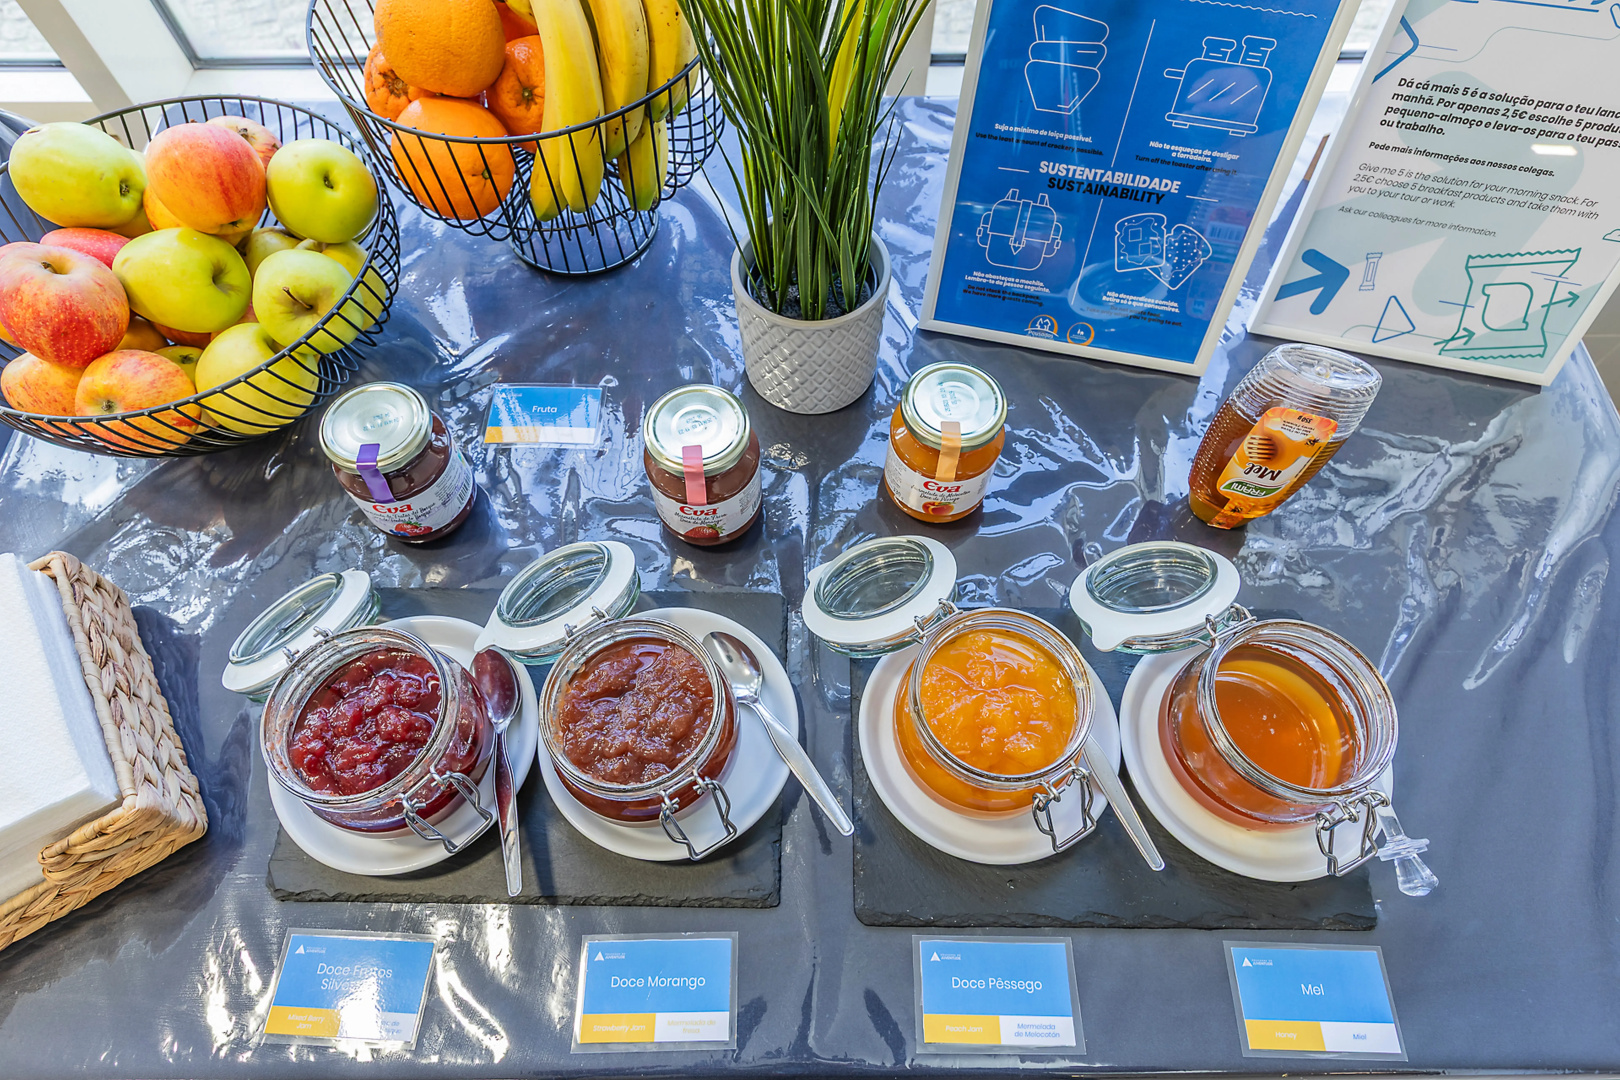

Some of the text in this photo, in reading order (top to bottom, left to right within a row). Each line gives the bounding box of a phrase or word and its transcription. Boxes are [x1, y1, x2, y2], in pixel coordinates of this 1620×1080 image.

[1398, 78, 1414, 88] Dá
[1415, 80, 1430, 90] cá
[1431, 84, 1460, 95] mais
[1462, 87, 1470, 96] 5
[1470, 88, 1479, 97] é
[1489, 93, 1535, 106] solução
[1534, 100, 1565, 110] para
[1575, 104, 1595, 114] teu
[1392, 93, 1434, 105] manhã.
[1436, 98, 1457, 108] Por
[1457, 102, 1501, 117] apenas
[1501, 108, 1528, 119] 2,5€
[1528, 113, 1573, 126] escolhe
[1575, 119, 1584, 127] 5
[995, 123, 1008, 131] Suja
[1014, 126, 1039, 135] mínimo
[1048, 130, 1063, 139] loiça
[1380, 119, 1445, 135] ou trabalho.
[1384, 106, 1483, 128] pequeno-almoço
[1492, 121, 1537, 135] leva-os
[1536, 129, 1566, 139] para
[1577, 134, 1596, 144] teu
[1048, 143, 1075, 153] crockery
[1149, 141, 1163, 149] Não
[1171, 146, 1202, 155] esqueças
[1172, 160, 1195, 170] toaster
[1177, 152, 1212, 163] torradeira.
[1369, 142, 1390, 151] Pede
[1391, 143, 1413, 154] mais
[1414, 148, 1469, 163] informações
[1486, 162, 1518, 171] nossos
[1518, 166, 1555, 176] colegas.
[1039, 160, 1181, 194] SUSTENTABILIDADE
[1047, 177, 1165, 205] SUSTAINABILITY
[1359, 163, 1379, 173] Give
[1380, 166, 1397, 175] me
[1397, 168, 1405, 177] 5
[1415, 172, 1431, 181] the
[1432, 174, 1469, 187] solution
[1469, 180, 1484, 188] for
[1483, 183, 1507, 193] your
[1506, 186, 1549, 201] morning
[1549, 193, 1579, 205] snack.
[1580, 199, 1599, 208] For
[1347, 185, 1366, 194] you
[1367, 187, 1377, 195] to
[1377, 190, 1400, 199] your
[1400, 193, 1421, 202] tour
[1432, 197, 1455, 208] work.
[1375, 177, 1409, 189] choose
[1419, 184, 1463, 197] breakfast
[1462, 189, 1505, 205] products
[1506, 198, 1527, 208] and
[1528, 201, 1549, 212] take
[1550, 205, 1576, 216] them
[1577, 210, 1599, 220] with
[1338, 205, 1353, 213] Ask
[1368, 210, 1413, 224] colleagues
[1413, 217, 1425, 225] for
[1425, 220, 1448, 229] more
[1447, 220, 1497, 237] information.
[532, 405, 558, 413] Fruta
[1244, 462, 1282, 481] Mel
[923, 481, 961, 493] Eva
[372, 504, 413, 513] Eva
[679, 506, 718, 516] Eva
[317, 963, 350, 976] Doce
[611, 976, 705, 990] Doce Morango
[952, 977, 1042, 994] Doce Pêssego
[1301, 984, 1325, 995] Mel
[1275, 1031, 1297, 1040] Honey
